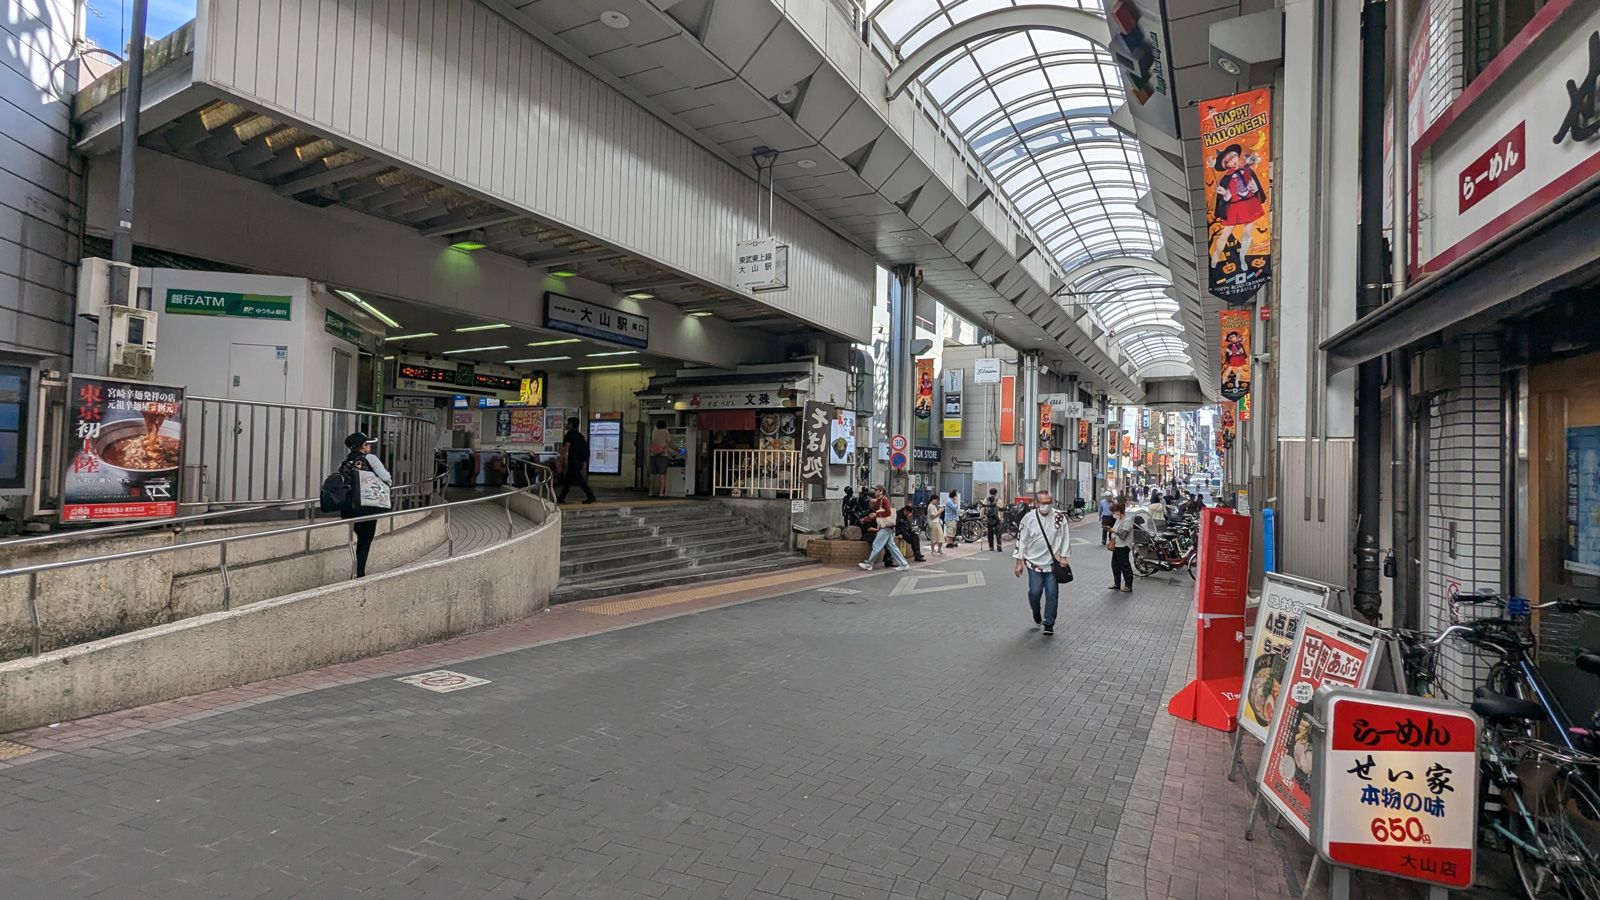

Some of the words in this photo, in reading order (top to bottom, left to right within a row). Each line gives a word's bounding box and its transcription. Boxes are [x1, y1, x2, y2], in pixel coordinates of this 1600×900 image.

[1213, 104, 1249, 128] HAPPY
[1203, 112, 1268, 147] HALLOWEEN
[1463, 141, 1519, 200] らーめん
[739, 262, 772, 274] 大山駅
[171, 293, 225, 308] 銀行ATM
[255, 308, 288, 317] ゆうちょ銀行
[580, 306, 628, 331] 大山駅
[744, 392, 770, 406] 文殊
[913, 449, 923, 458] OOK
[924, 449, 938, 459] STORE
[1327, 651, 1360, 678] あぶら
[1352, 717, 1449, 747] らーめん
[1346, 754, 1455, 795] せい家
[1360, 783, 1445, 818] 本物の味
[1370, 816, 1432, 845] 650円
[1401, 854, 1457, 877] 大山店
